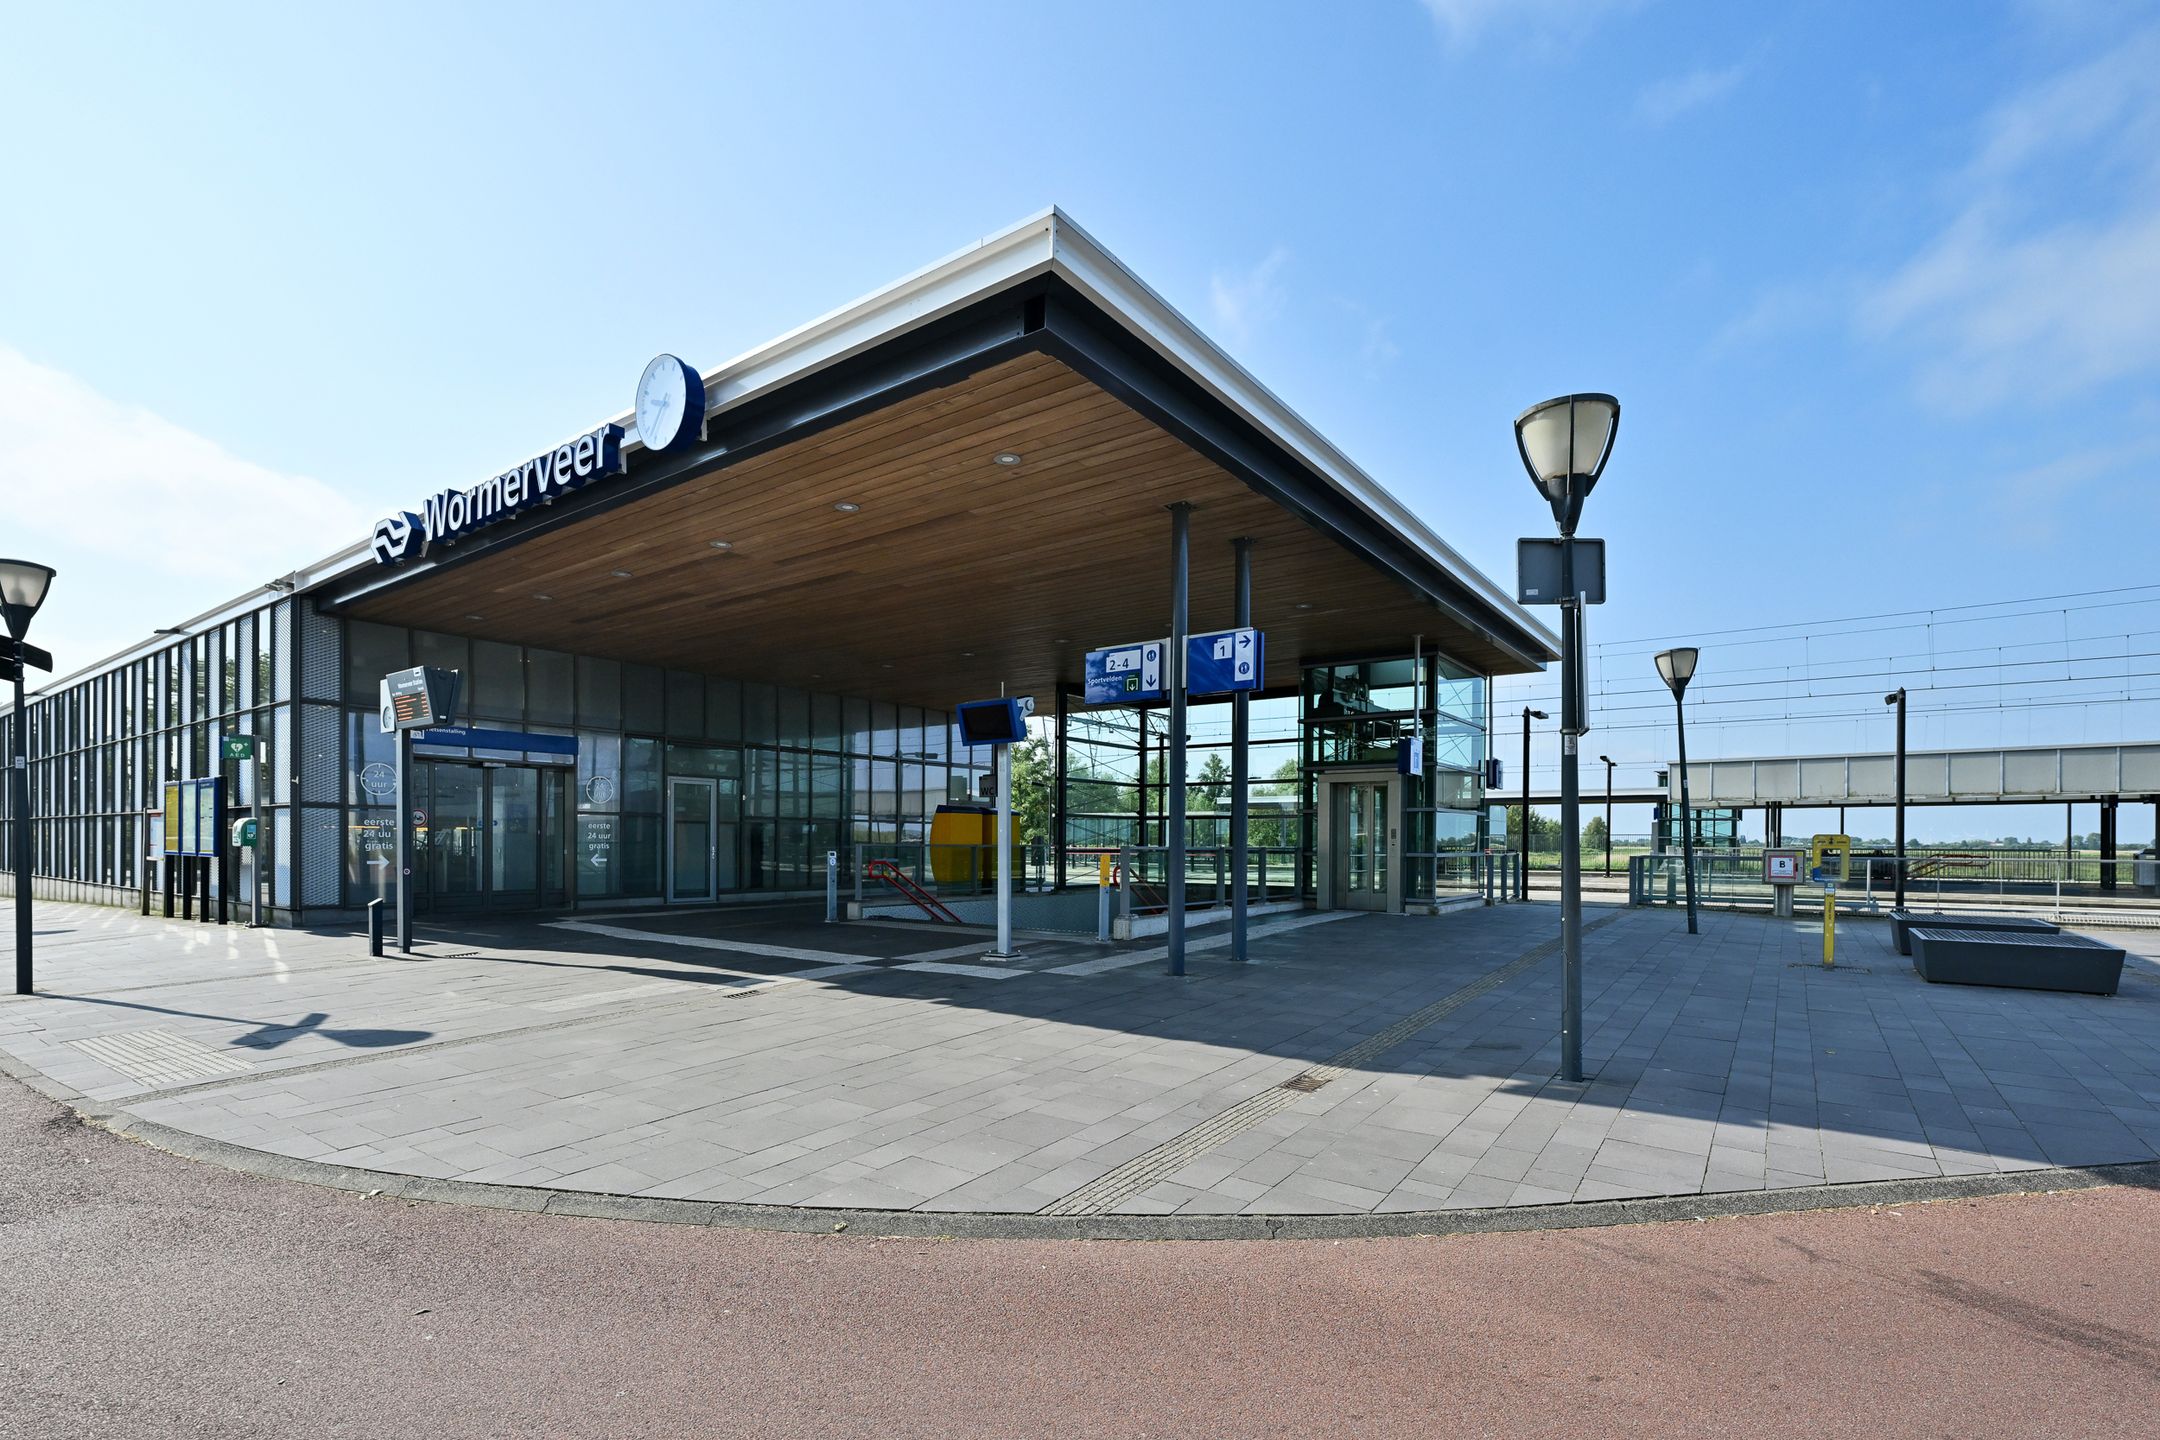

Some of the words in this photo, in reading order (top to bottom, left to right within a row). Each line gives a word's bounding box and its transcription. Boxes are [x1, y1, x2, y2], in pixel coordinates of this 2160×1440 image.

[423, 423, 613, 542] Wormerveer
[1219, 645, 1226, 657] 1
[1087, 676, 1122, 686] Sportvelden
[373, 770, 385, 778] 24
[980, 786, 995, 796] WC
[363, 829, 375, 838] 24
[365, 842, 393, 851] gratis
